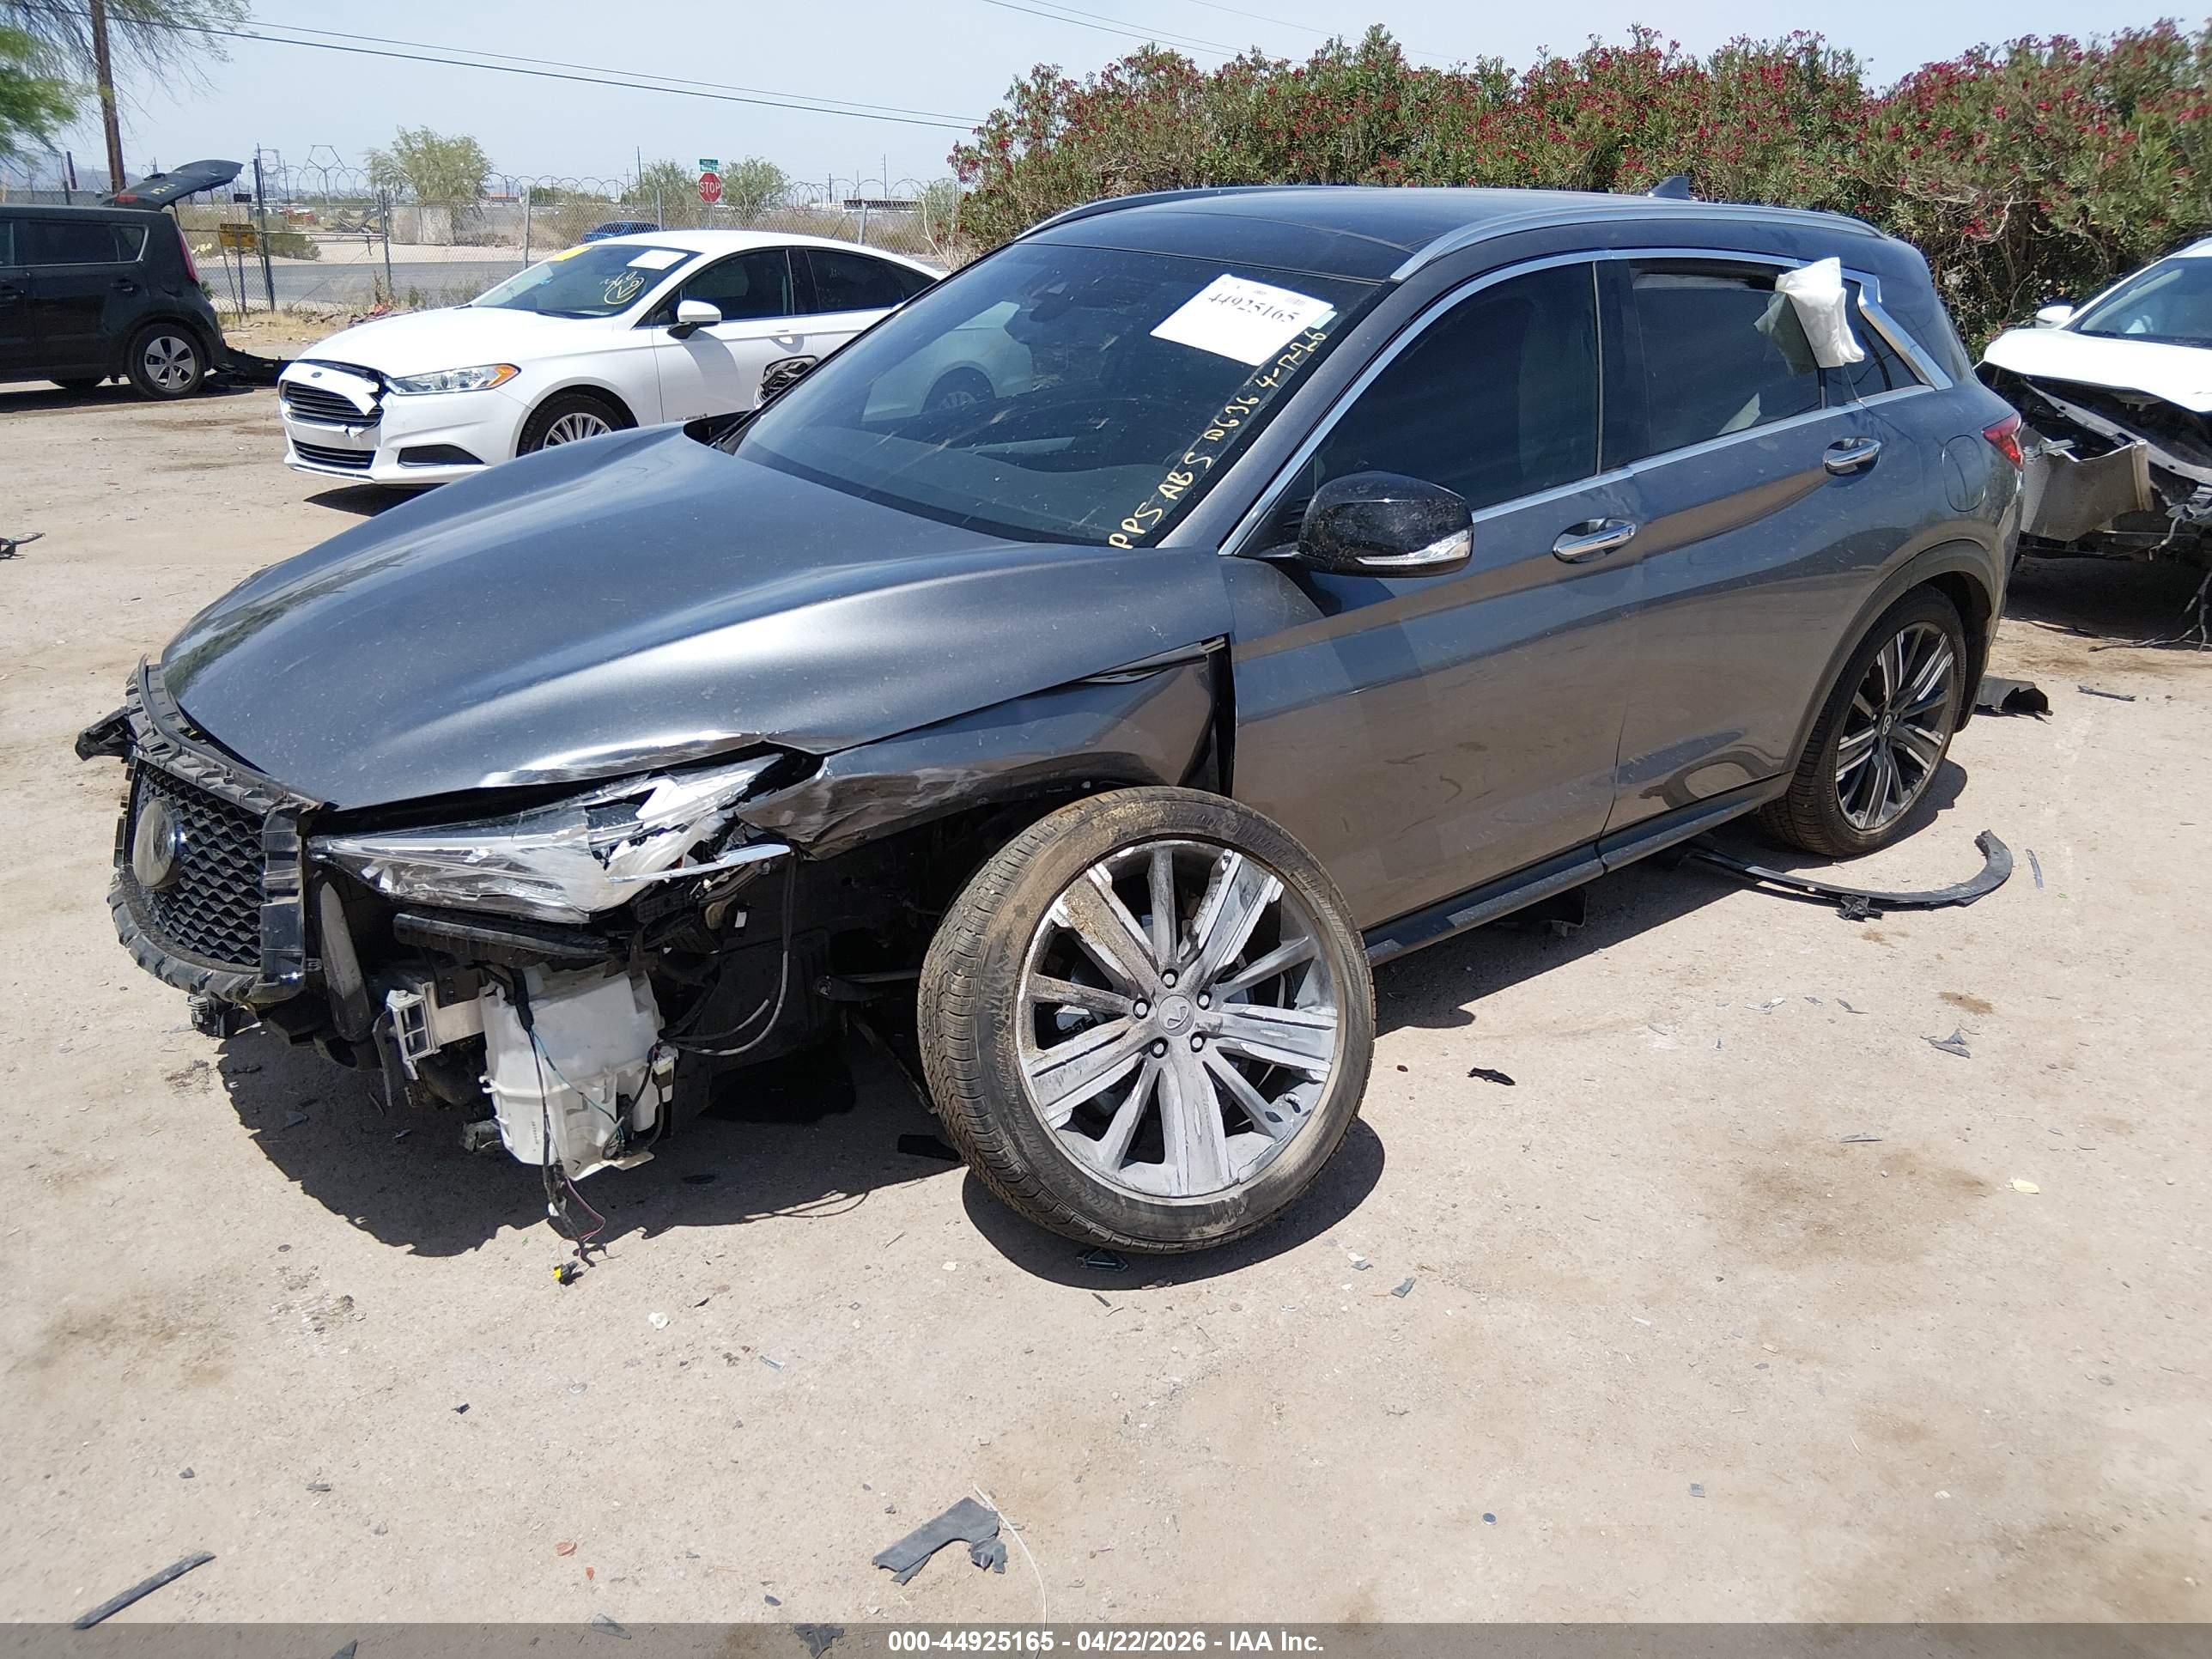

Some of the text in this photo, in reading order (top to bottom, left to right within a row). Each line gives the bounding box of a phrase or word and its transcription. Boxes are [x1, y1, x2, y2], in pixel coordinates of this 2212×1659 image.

[699, 181, 720, 193] STOP
[1208, 292, 1300, 323] 44925165
[1158, 452, 1214, 501] ABS
